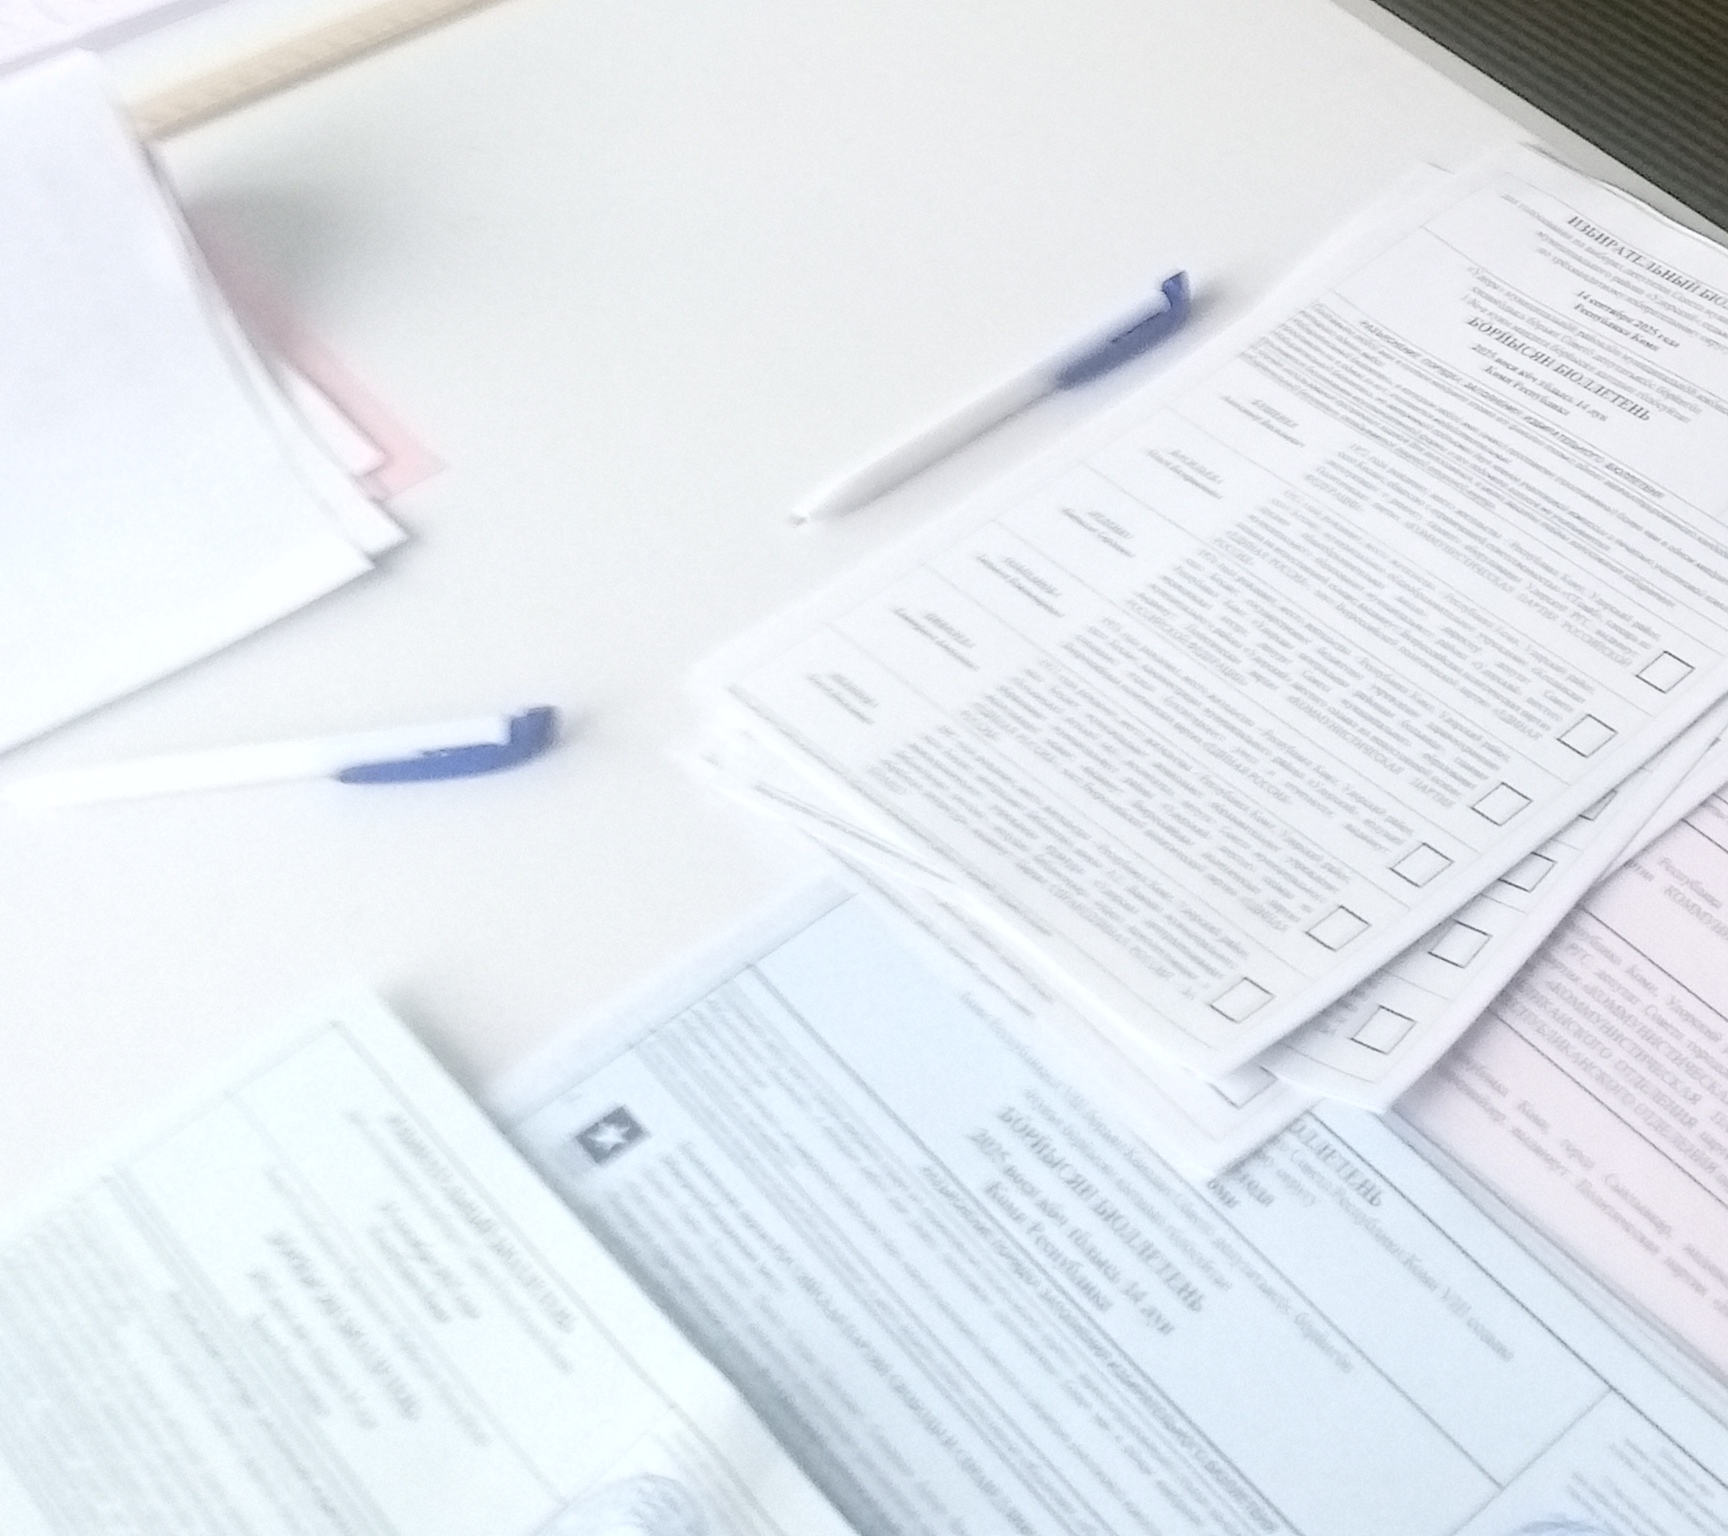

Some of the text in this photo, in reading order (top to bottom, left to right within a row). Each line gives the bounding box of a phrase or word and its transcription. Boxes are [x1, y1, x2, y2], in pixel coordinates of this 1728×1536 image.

[1562, 215, 1705, 294] ИЗБИРАТЕЛЬНЫЙ
[1572, 302, 1634, 338] Республика
[1550, 361, 1656, 423] БЮЛЛЕТЕНЬ
[1283, 1119, 1394, 1209] ЛЛЕТЕНЬ
